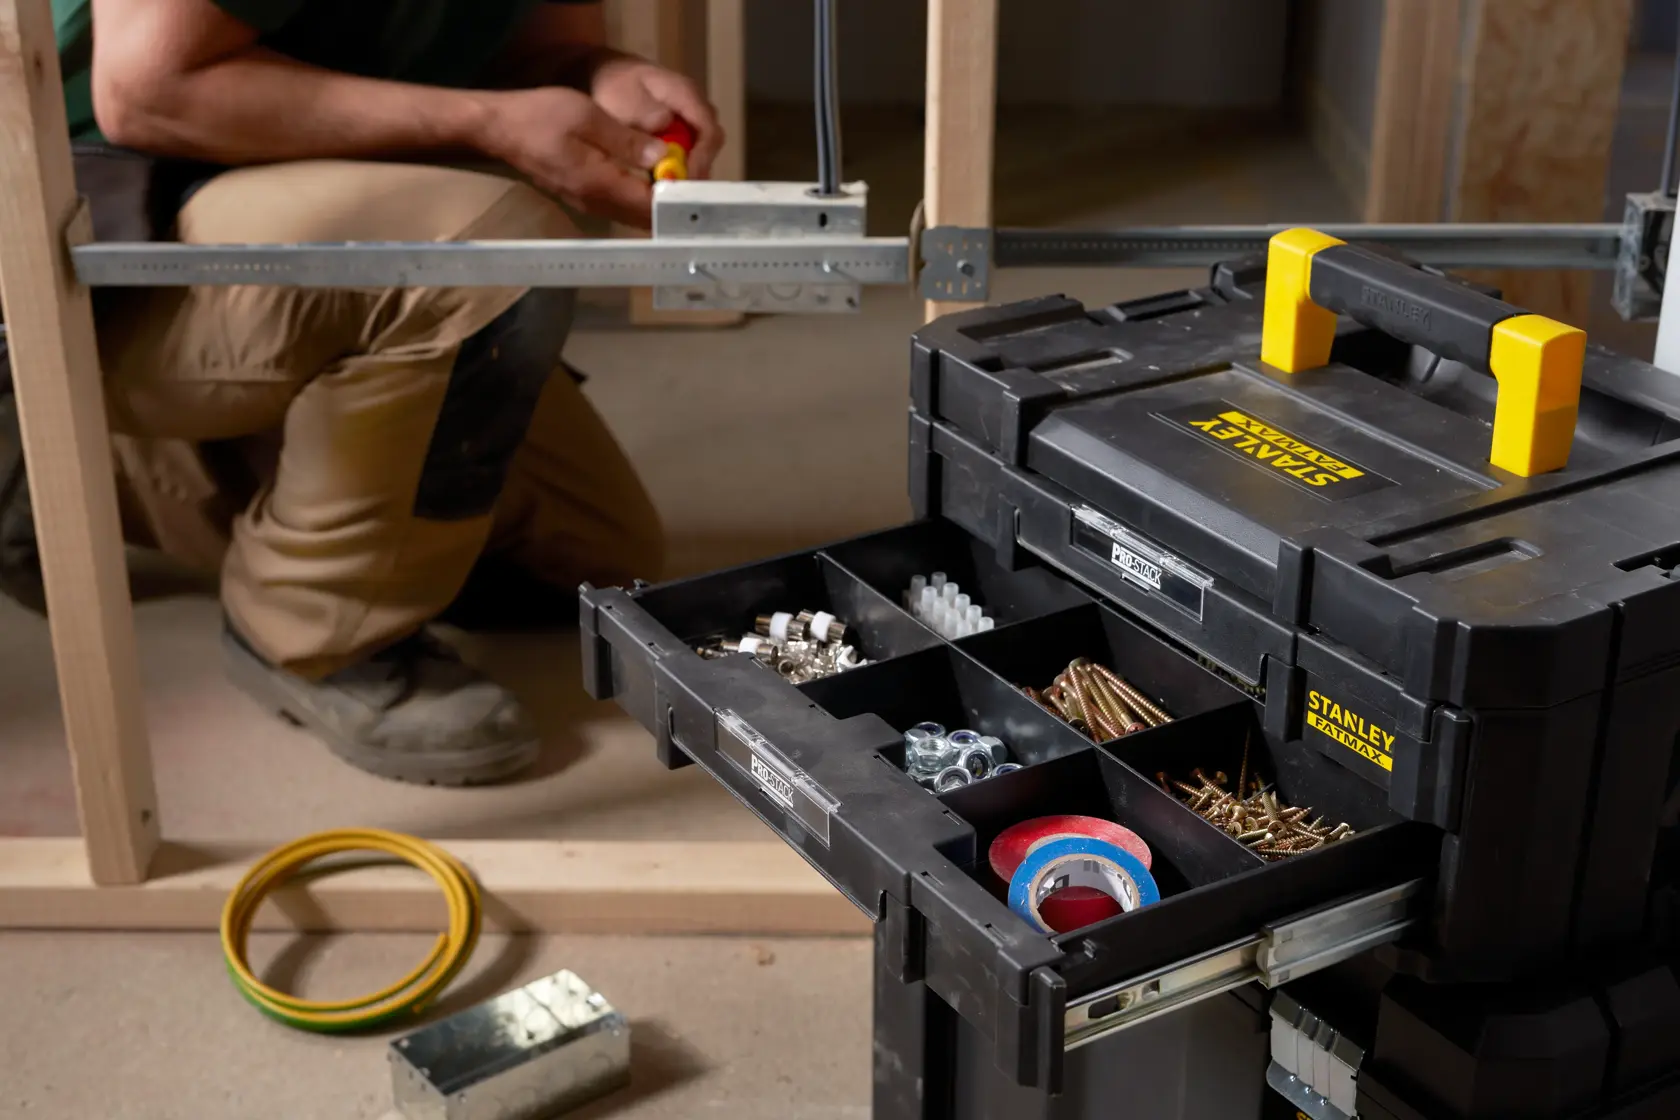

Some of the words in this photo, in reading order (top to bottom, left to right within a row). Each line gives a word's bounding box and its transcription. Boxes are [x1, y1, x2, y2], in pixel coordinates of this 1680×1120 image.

[1188, 419, 1341, 487] STANLEY
[1238, 419, 1349, 473] FATMAX
[1111, 541, 1163, 587] PRO-STACK
[1308, 690, 1395, 752] STANLEY
[1315, 716, 1382, 765] FATMAX
[751, 753, 794, 805] PRO-STACK
